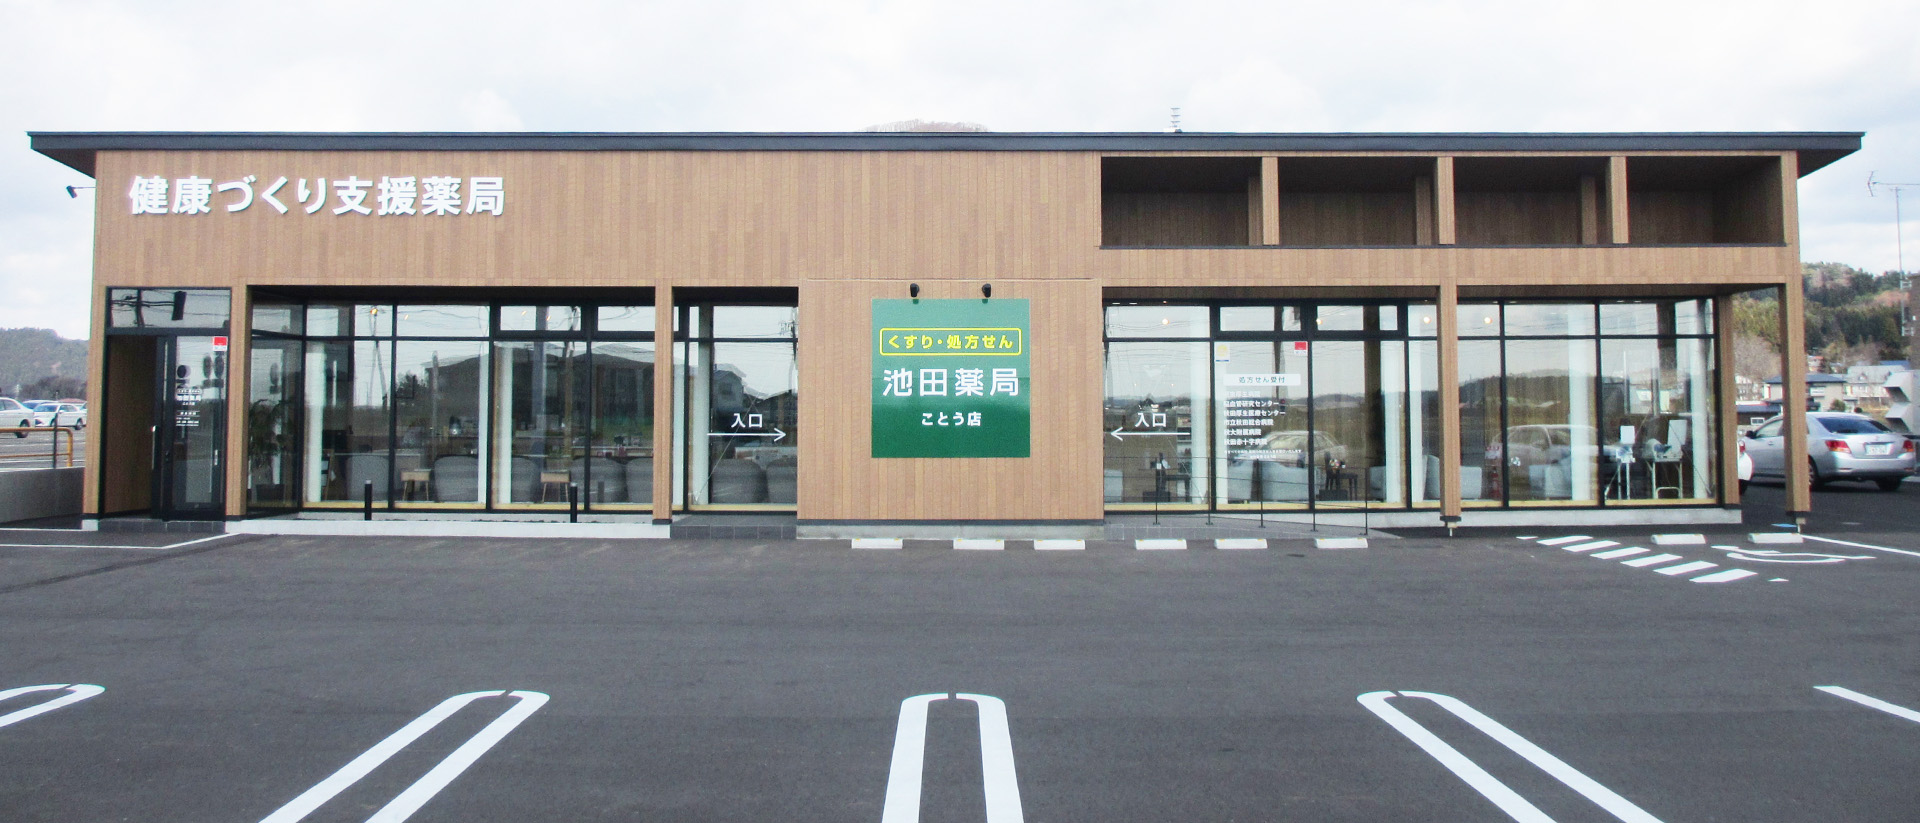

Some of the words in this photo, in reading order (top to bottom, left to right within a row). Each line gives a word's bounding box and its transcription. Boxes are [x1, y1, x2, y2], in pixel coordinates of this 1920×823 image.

[129, 175, 505, 216] 健康づくり支援薬局
[888, 334, 1014, 350] くすり・処方せん
[882, 367, 1019, 397] 池田薬局
[1238, 376, 1286, 384] 処方せん受付
[731, 412, 763, 428] 入口
[921, 411, 982, 427] ことう店
[1134, 412, 1167, 428] 入口
